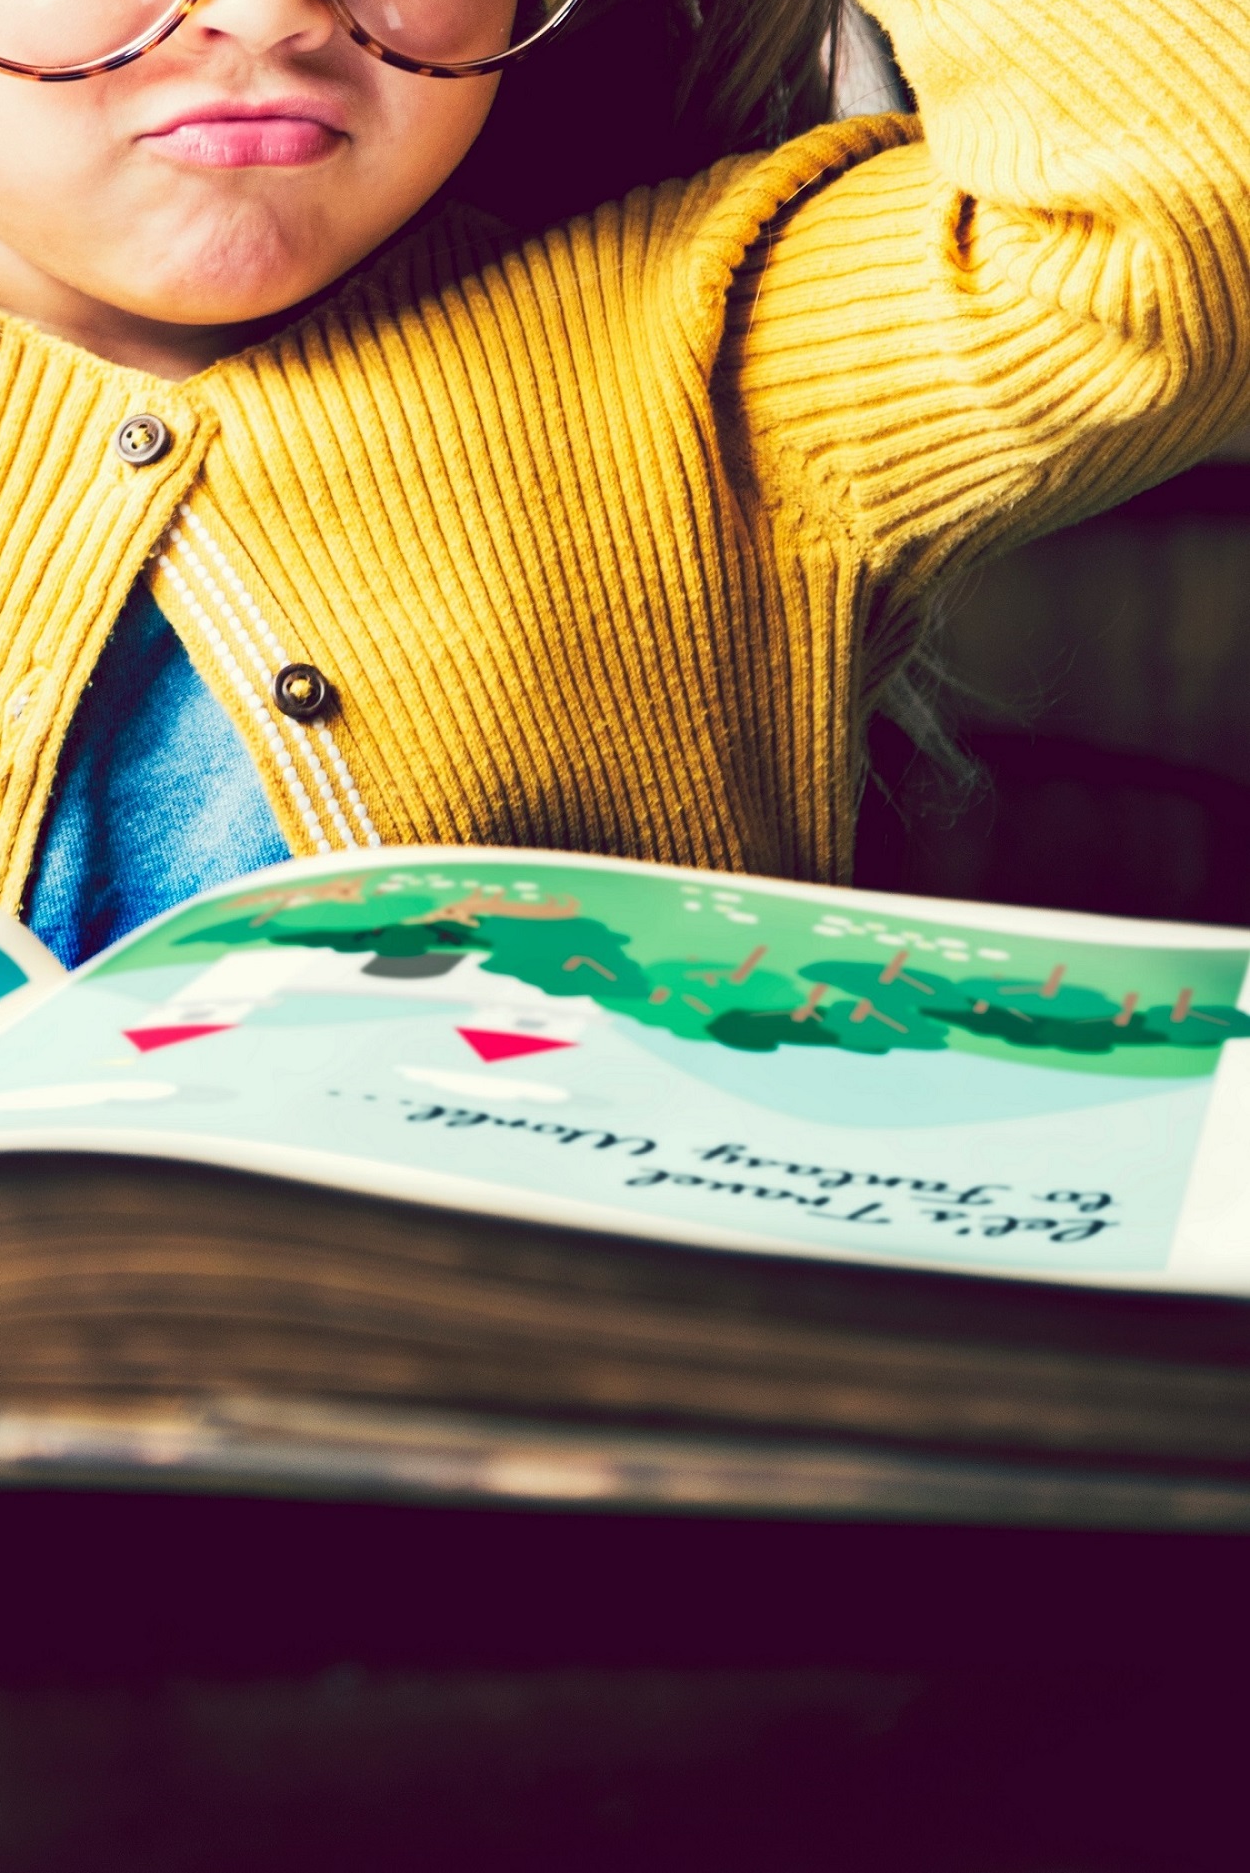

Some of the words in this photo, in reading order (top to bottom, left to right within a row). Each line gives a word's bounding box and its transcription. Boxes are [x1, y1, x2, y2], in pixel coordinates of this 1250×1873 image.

[624, 1166, 892, 1225] Travel
[694, 1142, 1012, 1205] Fantasy
[1031, 1190, 1115, 1213] to
